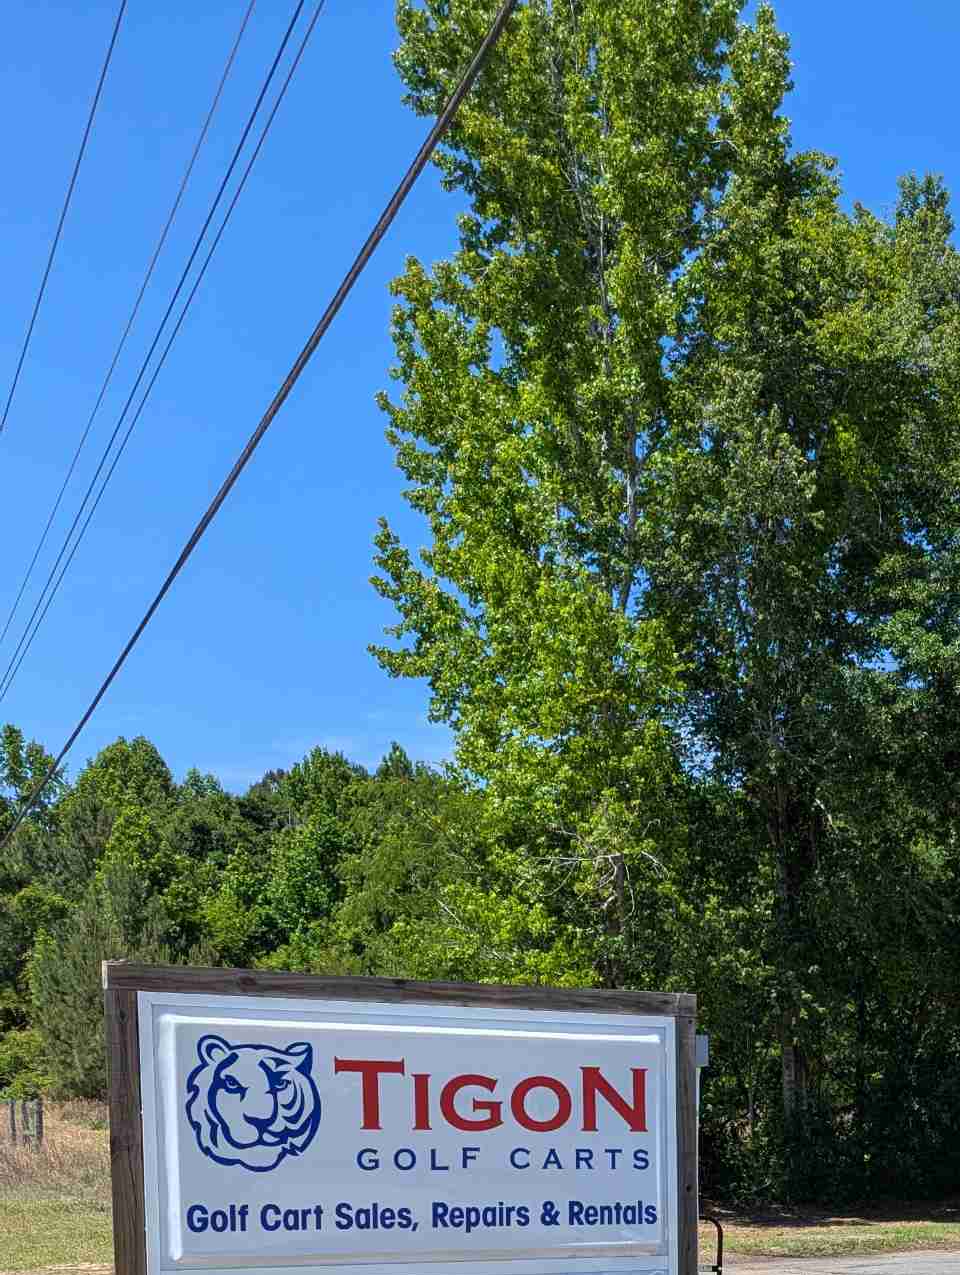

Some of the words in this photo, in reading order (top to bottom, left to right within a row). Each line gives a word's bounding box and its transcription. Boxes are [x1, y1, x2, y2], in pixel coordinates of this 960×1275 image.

[335, 1056, 648, 1132] TIGON
[356, 1146, 482, 1171] GOLF
[509, 1147, 650, 1171] CARTS
[186, 1203, 249, 1234] Golf
[259, 1203, 324, 1232] Cart
[334, 1202, 420, 1232] Sales,
[431, 1201, 530, 1234] Repairs
[540, 1200, 561, 1227] &
[568, 1199, 658, 1226] Rentals
